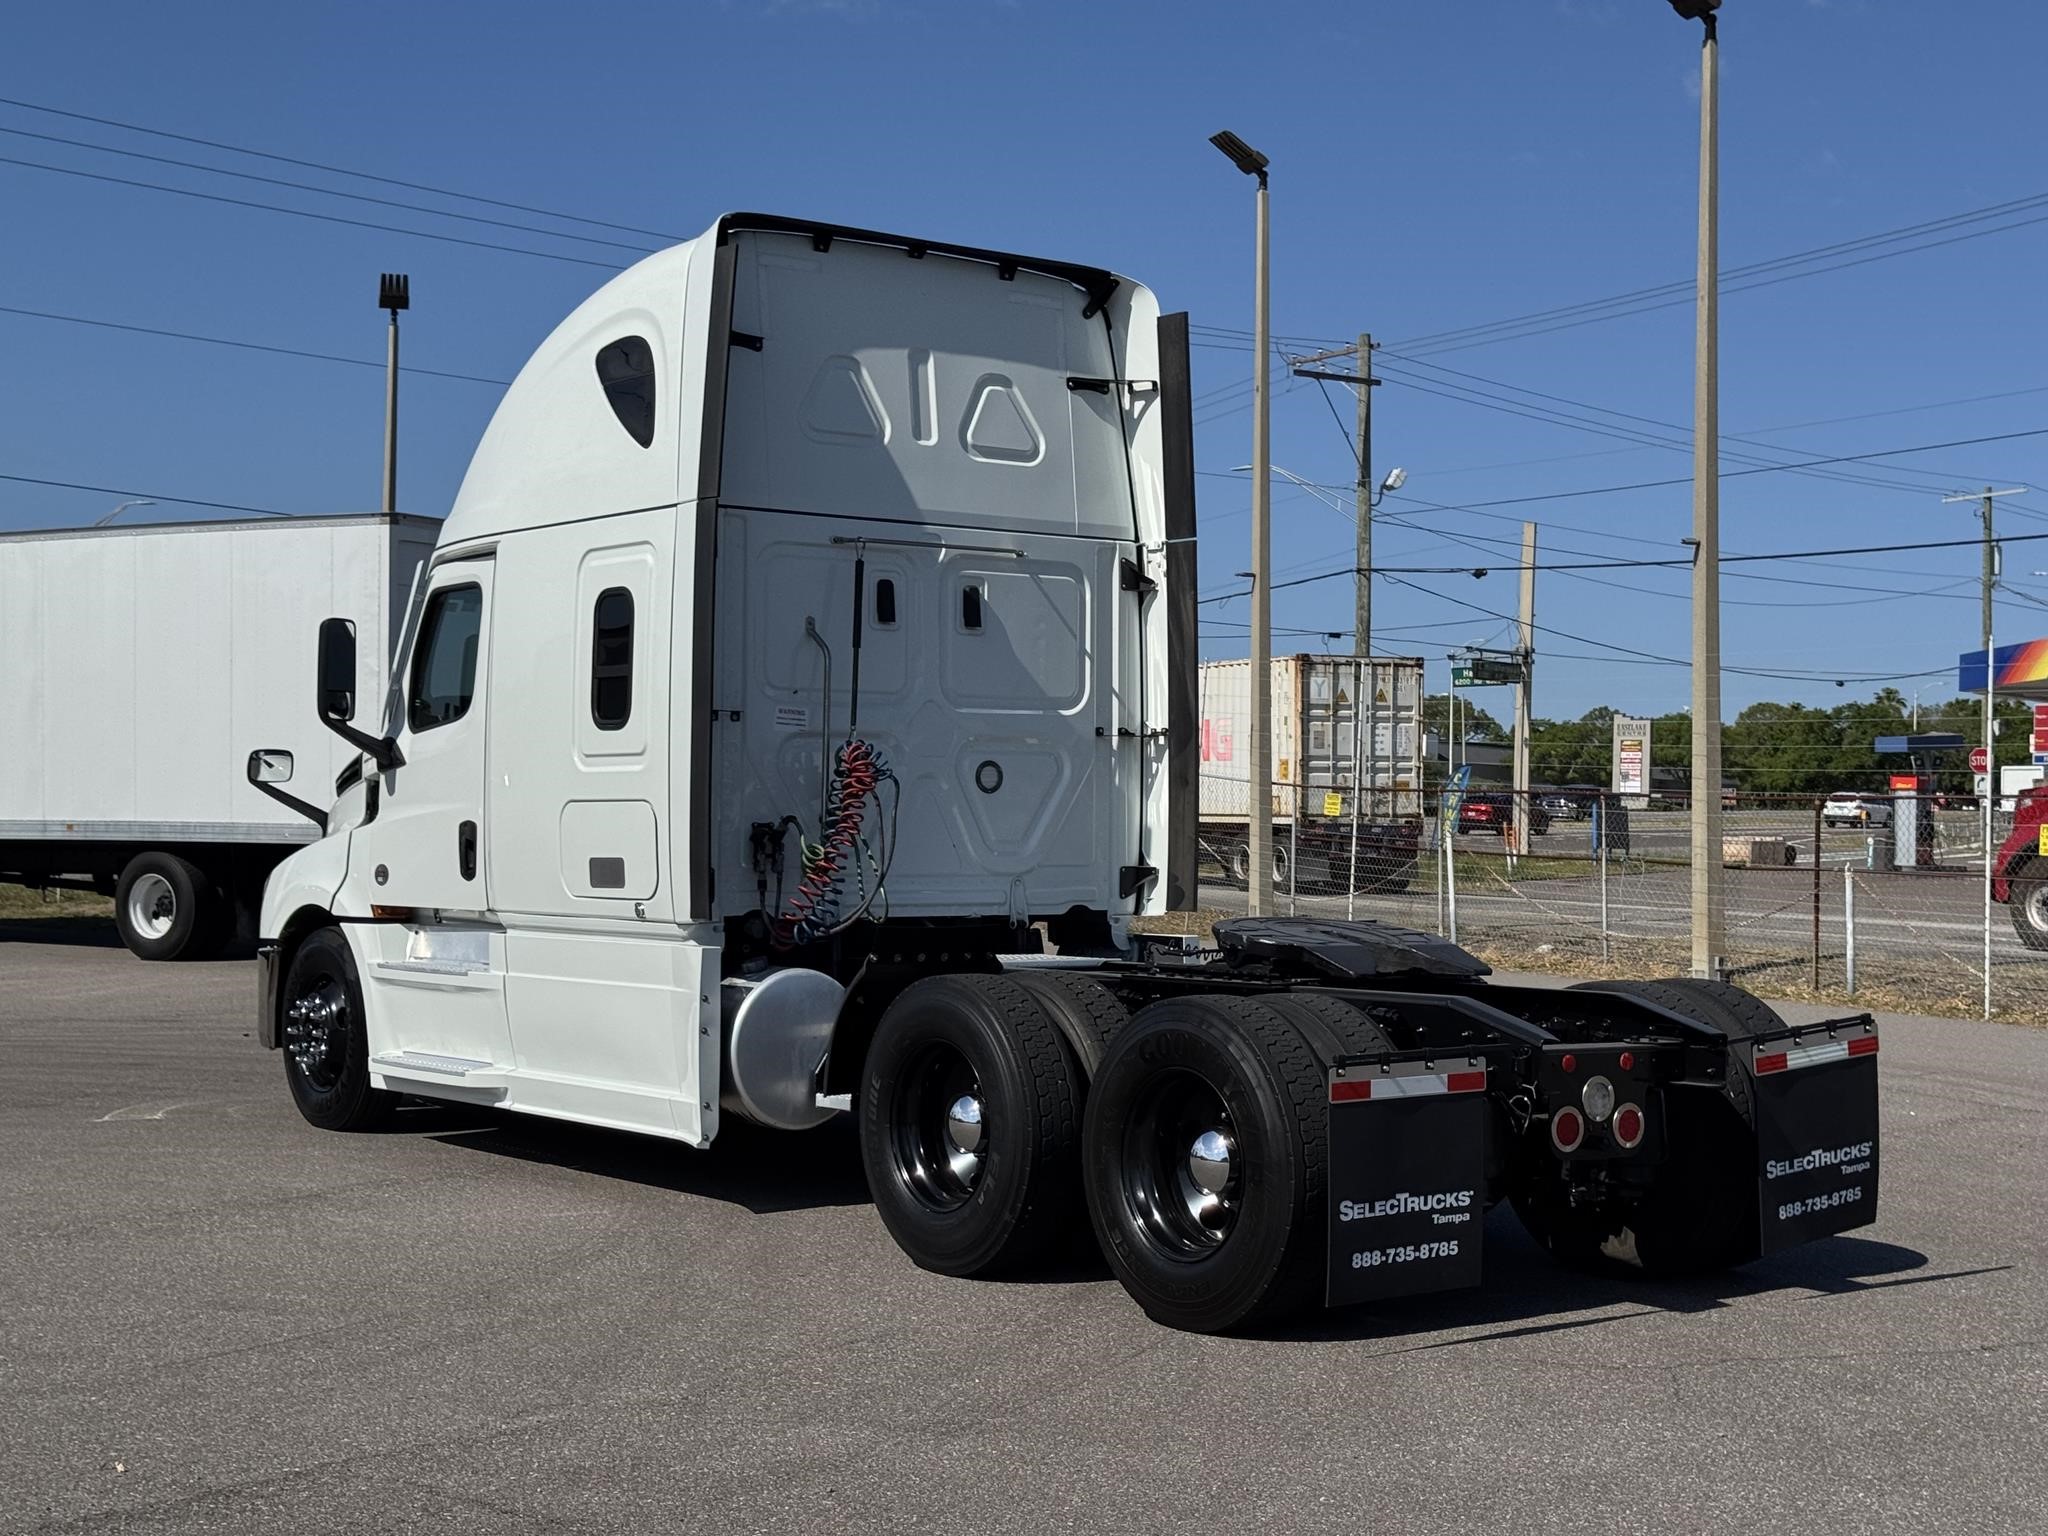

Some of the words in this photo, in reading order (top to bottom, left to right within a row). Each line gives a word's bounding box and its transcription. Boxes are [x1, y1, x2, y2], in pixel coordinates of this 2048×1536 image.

[1971, 756, 1987, 767] STO
[1841, 1161, 1871, 1175] Tampa
[1778, 1186, 1862, 1220] 888-735-8785
[1432, 1213, 1470, 1224] Tampa
[1351, 1240, 1459, 1269] 888-735-8785
